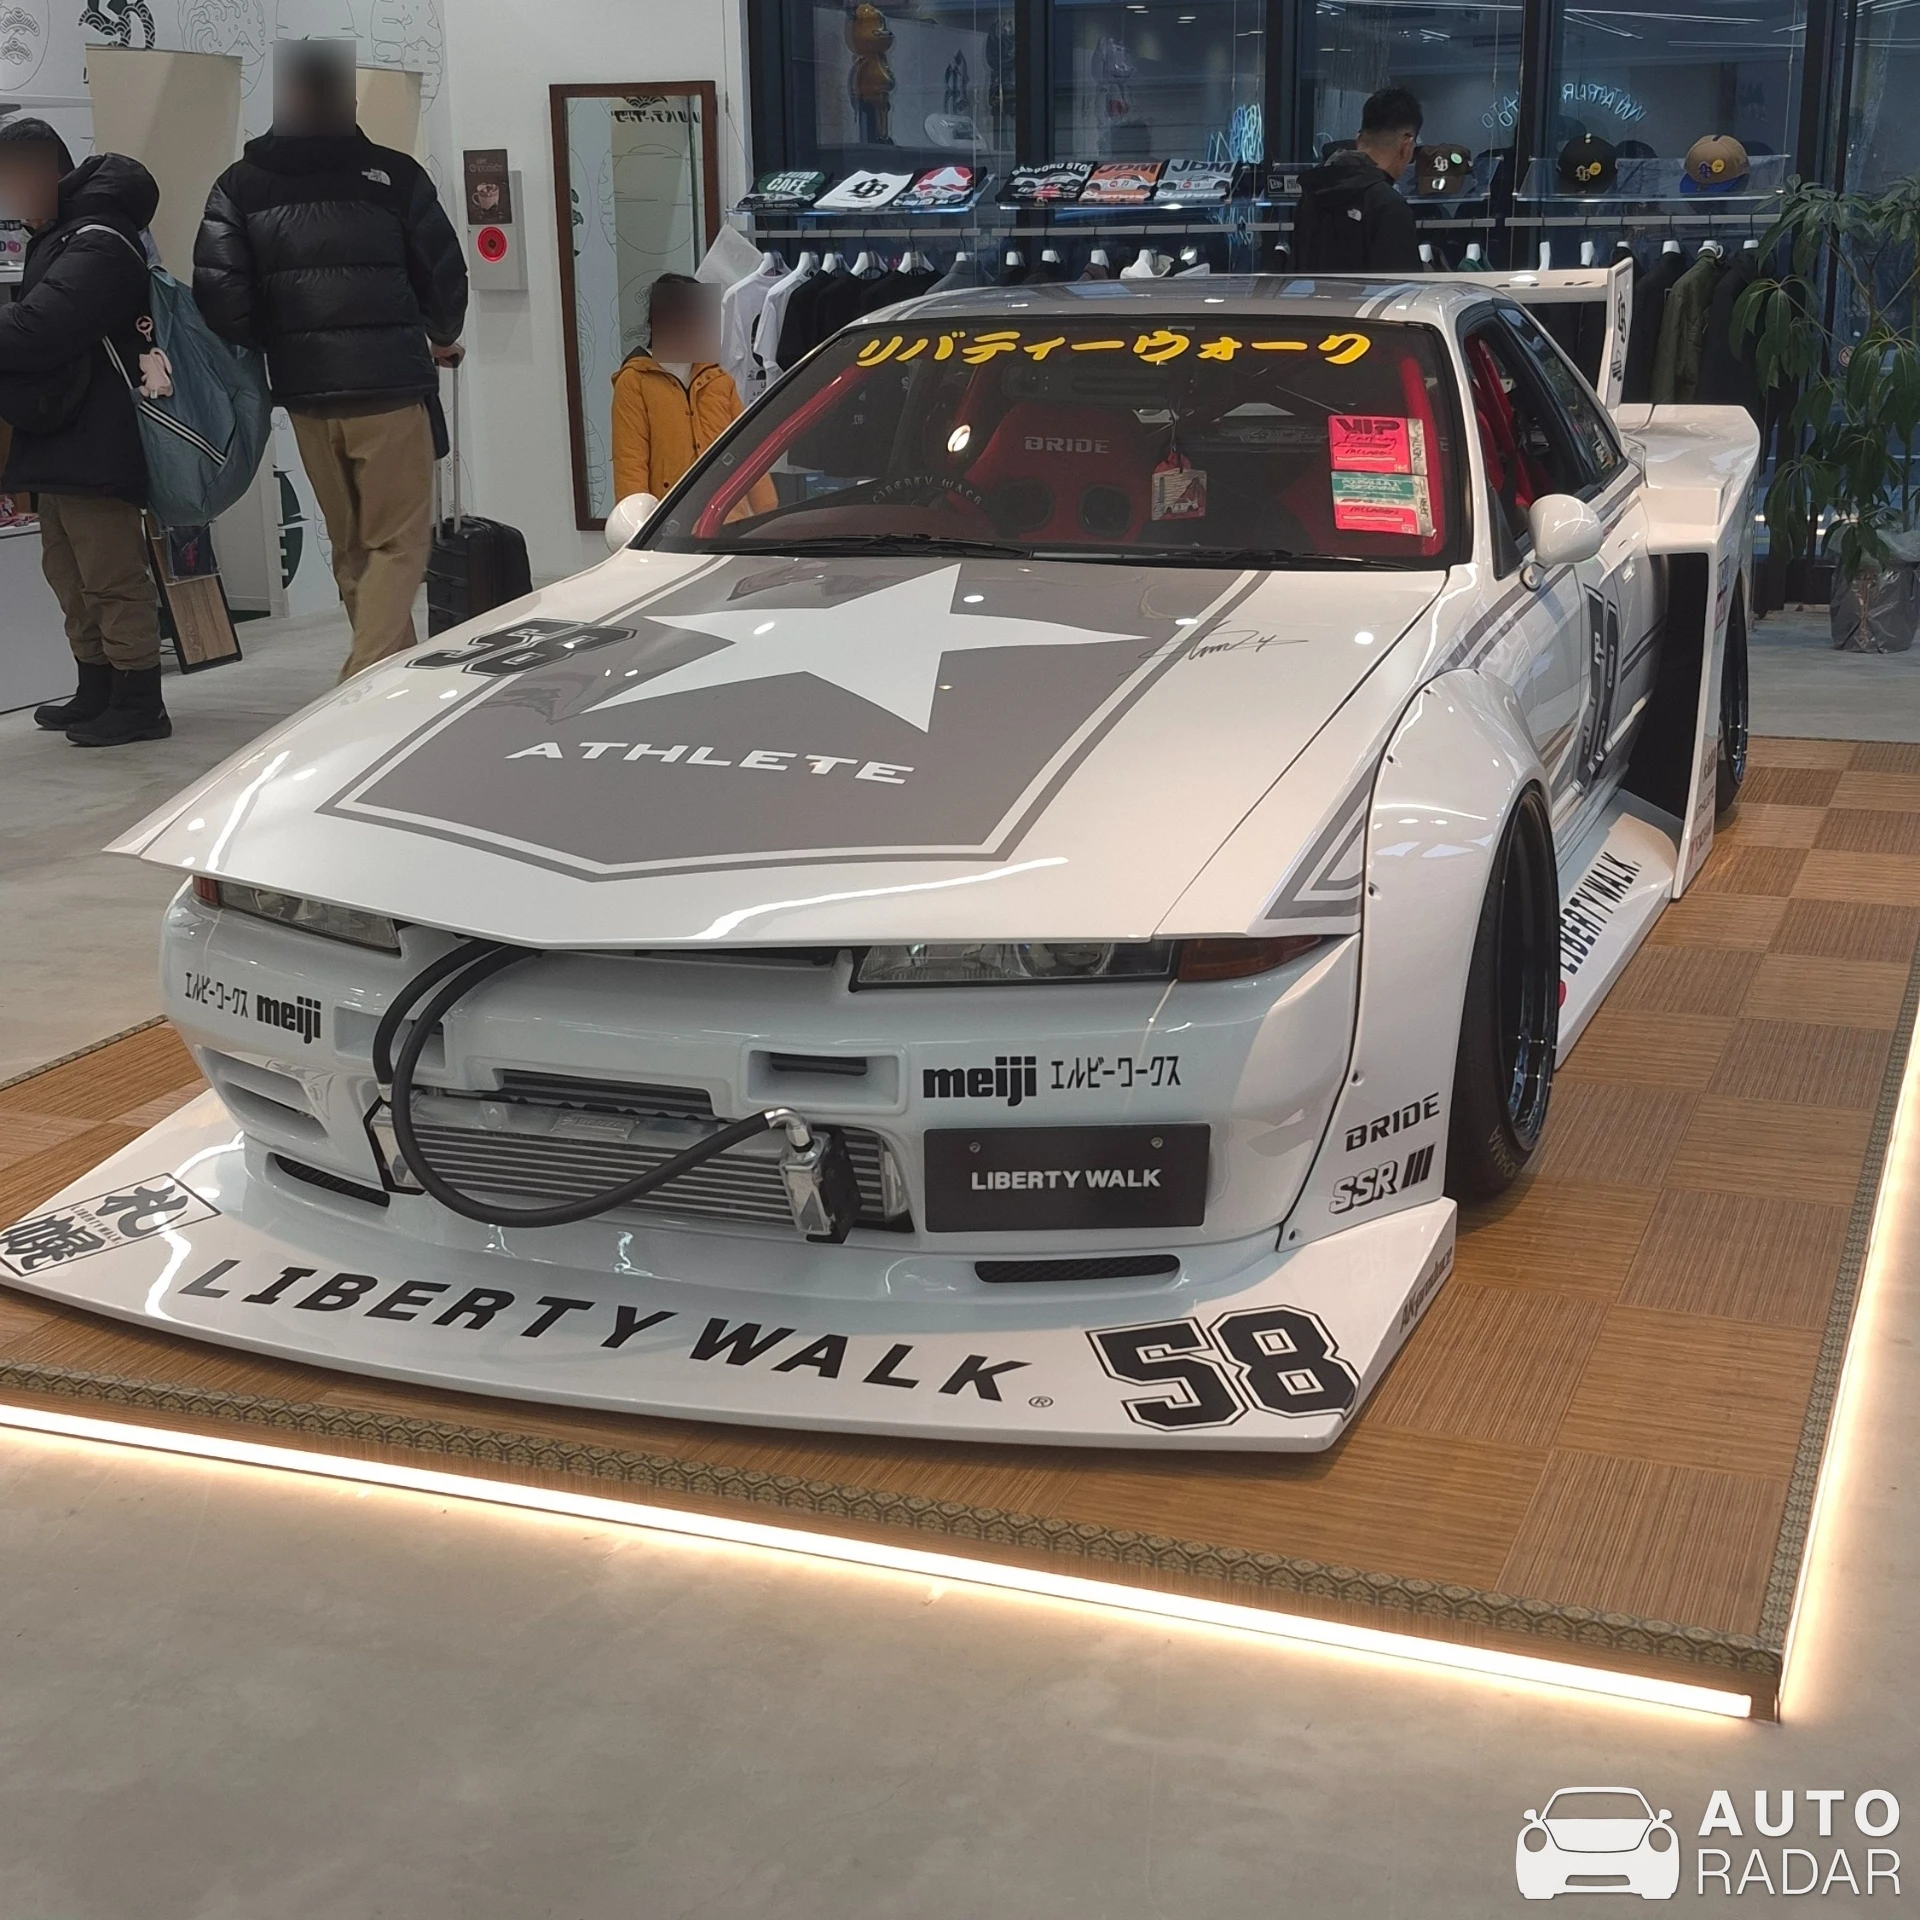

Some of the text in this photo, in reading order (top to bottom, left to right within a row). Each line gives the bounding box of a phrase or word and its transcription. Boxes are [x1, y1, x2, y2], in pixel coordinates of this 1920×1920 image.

[766, 178, 810, 194] CAFE
[857, 331, 1371, 366] リバティーウォーク
[1024, 436, 1111, 454] BRIDE
[1335, 418, 1400, 435] VIP
[404, 618, 638, 677] 58
[504, 742, 915, 785] ATHLETE
[1582, 851, 1640, 903] WALK
[256, 994, 322, 1045] meiji
[922, 1056, 1038, 1107] meiji
[1345, 1091, 1440, 1152] BRIDE
[971, 1168, 1161, 1191] LIBERTY WALK
[178, 1259, 681, 1351] LIBERTY
[689, 1318, 1032, 1403] WALK
[1086, 1304, 1363, 1432] 58
